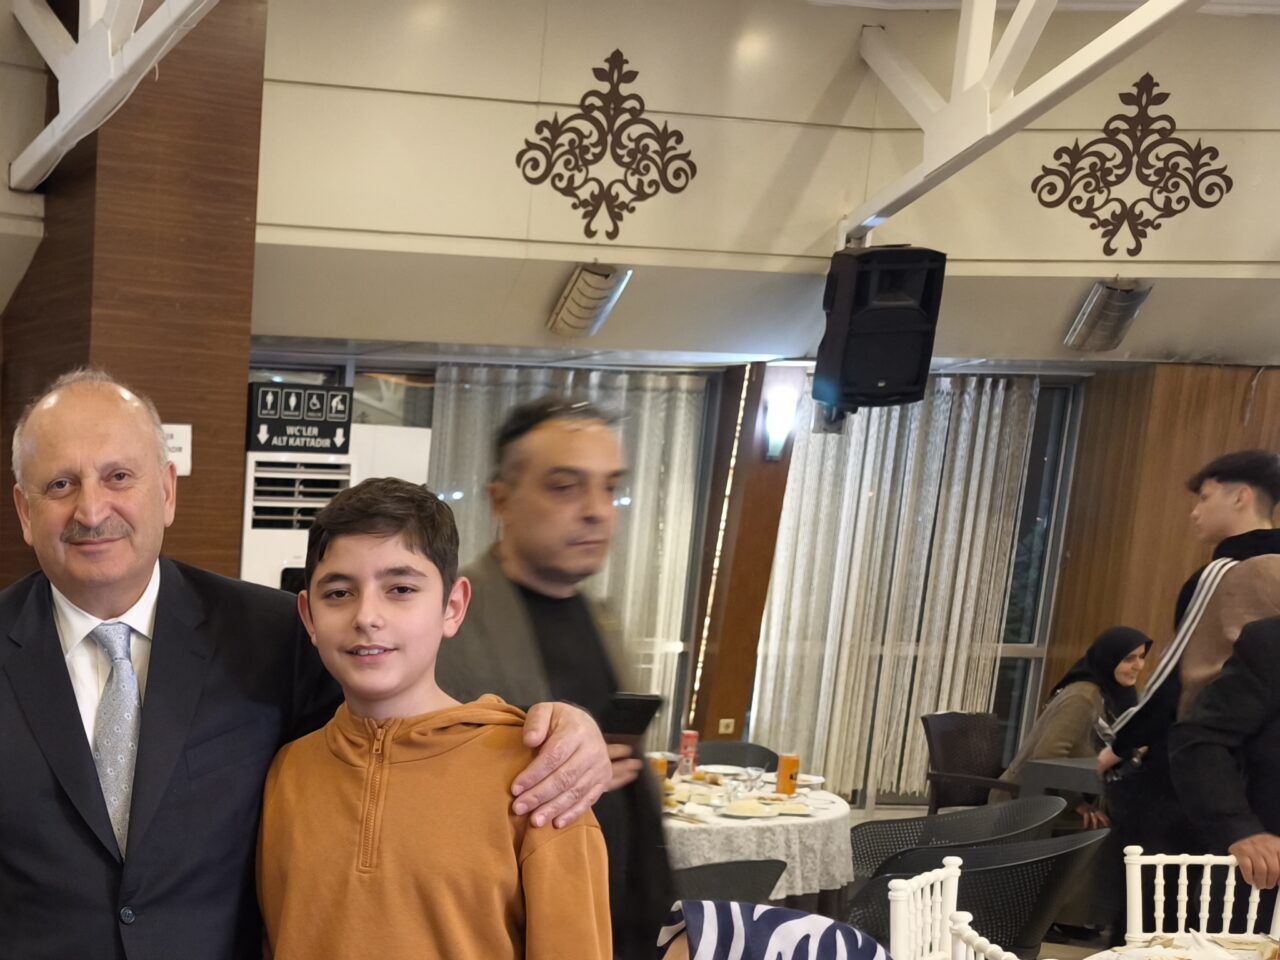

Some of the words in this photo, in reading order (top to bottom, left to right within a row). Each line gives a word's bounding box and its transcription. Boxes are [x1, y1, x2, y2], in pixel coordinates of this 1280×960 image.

[286, 425, 319, 437] WC'LER
[272, 436, 288, 446] ALT
[288, 437, 331, 448] KATTADIR
